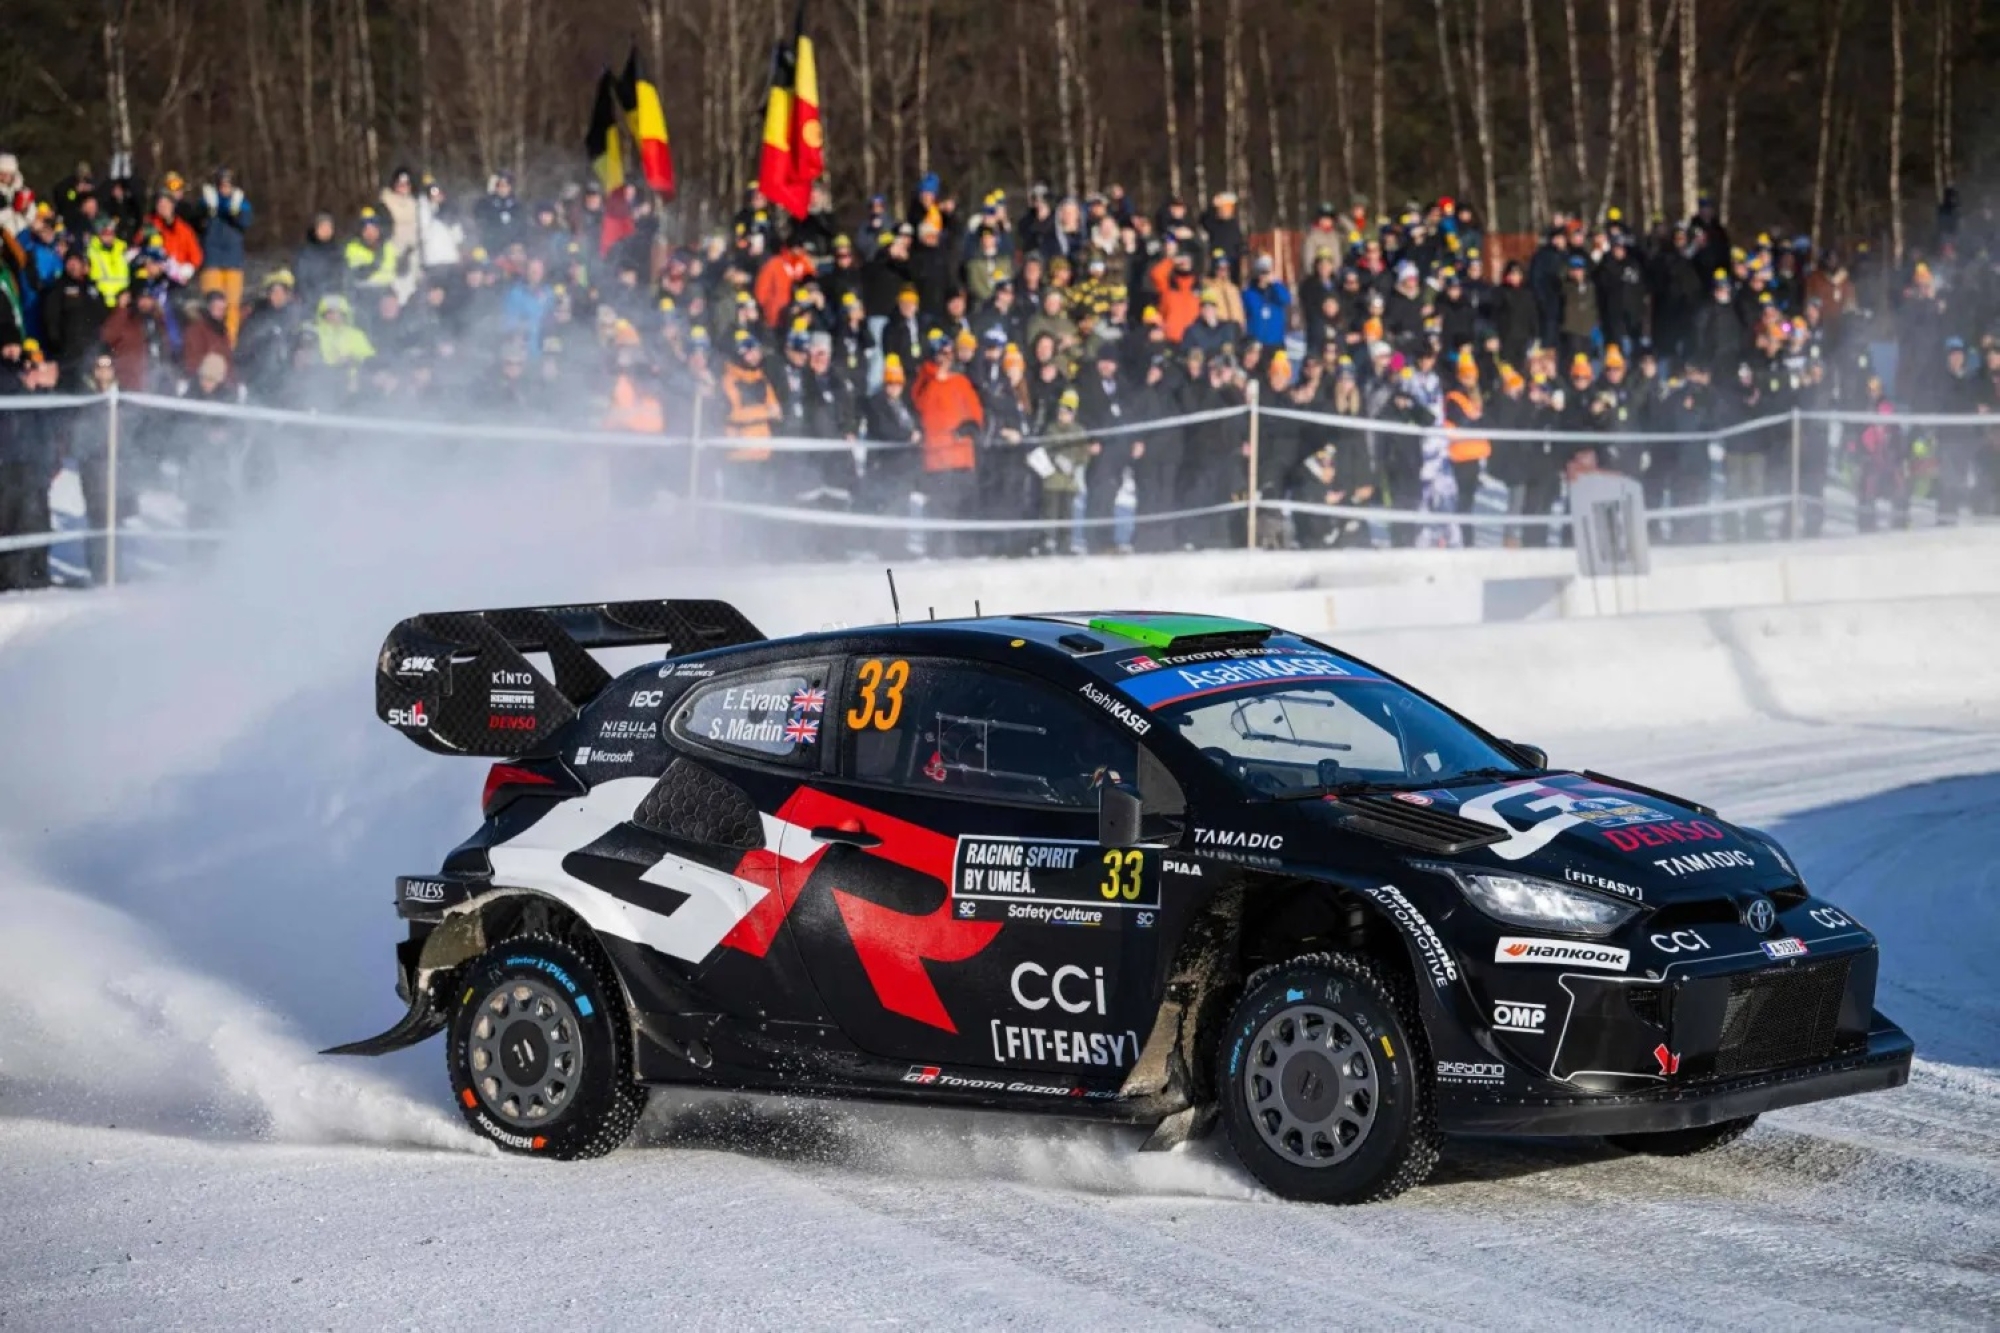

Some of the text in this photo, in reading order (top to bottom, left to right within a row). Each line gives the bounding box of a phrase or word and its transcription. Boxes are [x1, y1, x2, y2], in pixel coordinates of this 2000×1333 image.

[1159, 650, 1224, 666] TOYOTA
[1177, 658, 1352, 690] AsahiKASEI
[846, 659, 911, 731] 33
[387, 702, 429, 727] Stilo
[1079, 682, 1152, 736] AsahiKASEI
[489, 714, 537, 730] DENSO
[601, 720, 657, 733] NISULA
[590, 749, 635, 764] Microsoft
[1194, 827, 1284, 850] TAMADIC
[1603, 819, 1724, 852] DENSO
[965, 843, 1079, 869] RACING SPIRIT
[1653, 849, 1755, 876] TAMADIC
[964, 866, 1036, 894] BY UMEÅ.
[1101, 849, 1144, 900] 33
[1162, 859, 1203, 878] PIAA
[405, 880, 445, 899] ENDLESS
[959, 901, 976, 916] SC
[1007, 903, 1103, 924] SafetyCulture
[1136, 911, 1155, 925] SC
[1364, 888, 1448, 988] AUTOMOTIVE
[1493, 1005, 1546, 1028] OMP
[1437, 1061, 1505, 1076] akebono
[902, 1072, 932, 1084] GR
[938, 1075, 1005, 1090] TOYOTA
[1007, 1081, 1070, 1096] GAZOO
